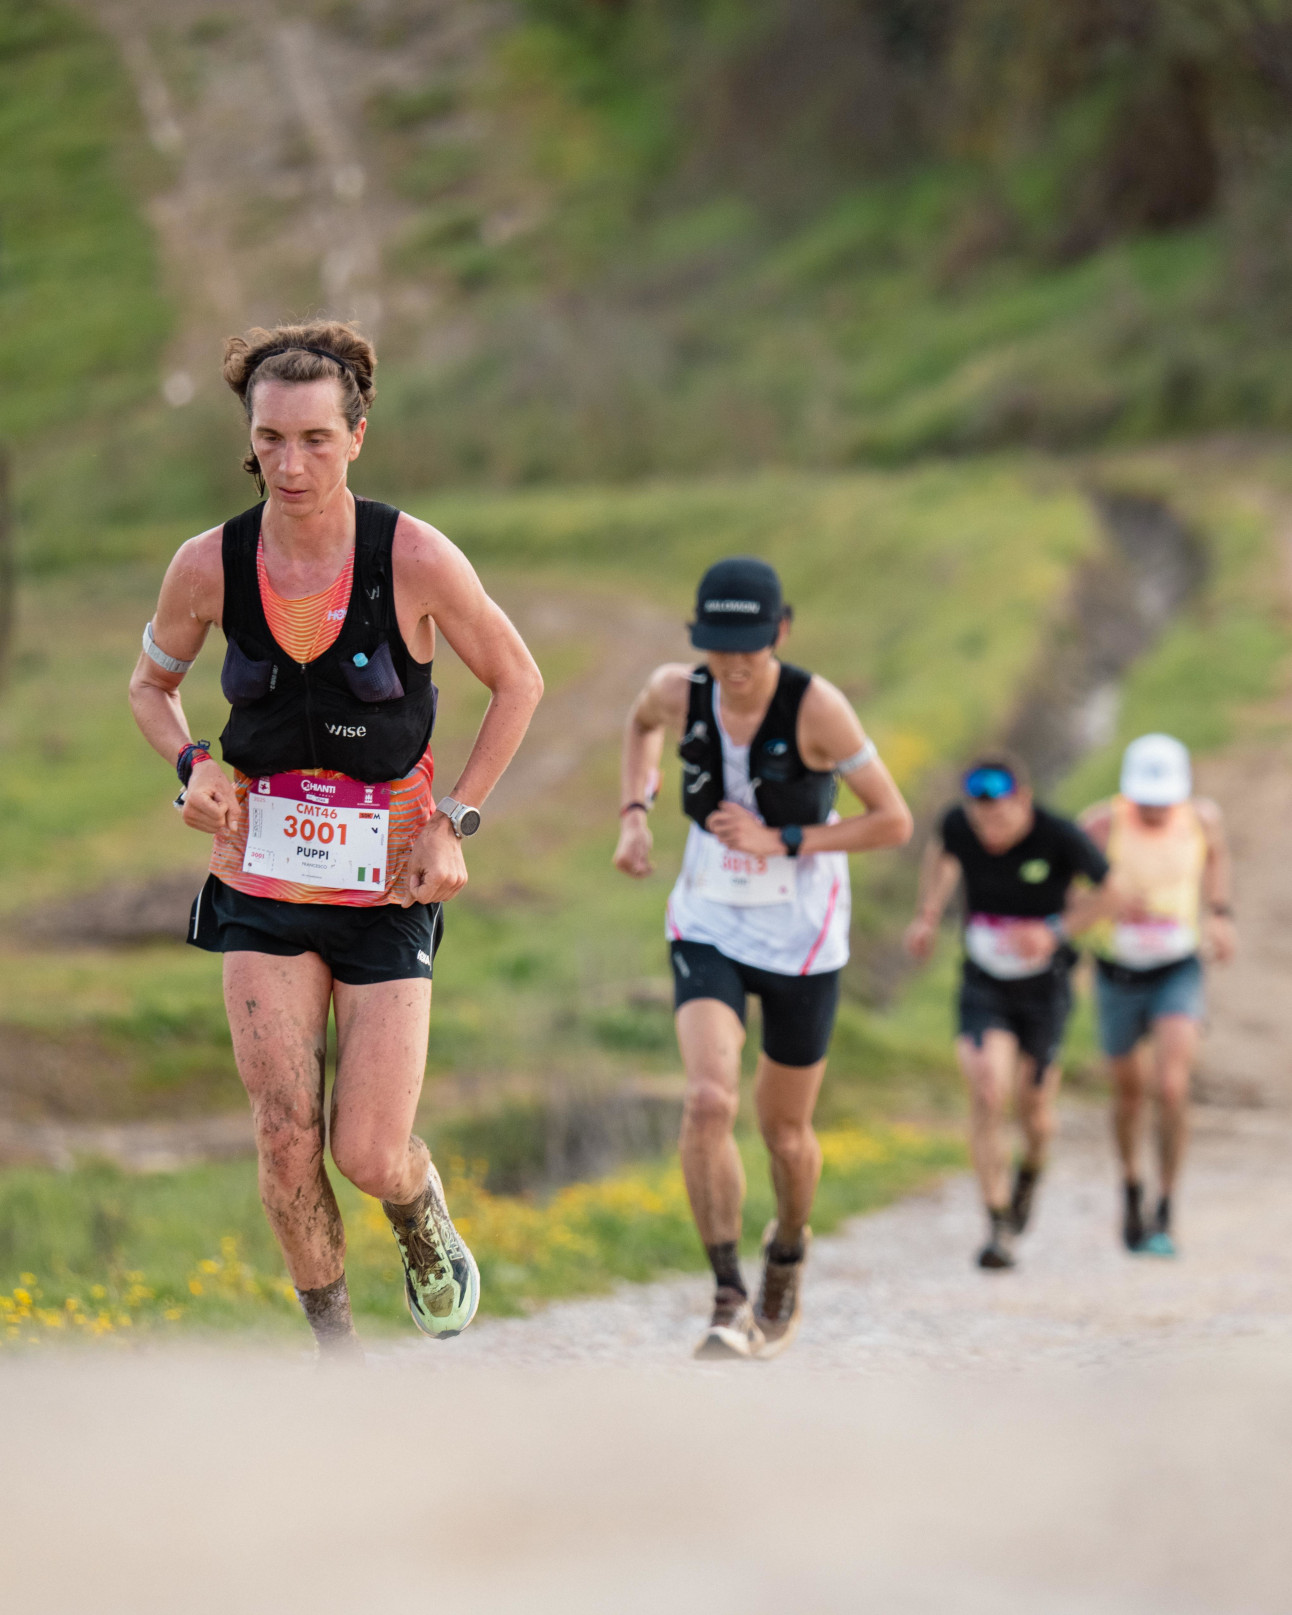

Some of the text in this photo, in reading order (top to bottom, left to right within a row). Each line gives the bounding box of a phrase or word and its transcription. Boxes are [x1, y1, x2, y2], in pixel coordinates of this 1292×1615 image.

[301, 780, 336, 794] CHIANTI
[296, 803, 338, 819] CMT46
[283, 815, 347, 846] 3001
[296, 846, 329, 860] PUPPI
[301, 861, 328, 870] FRANCESCO
